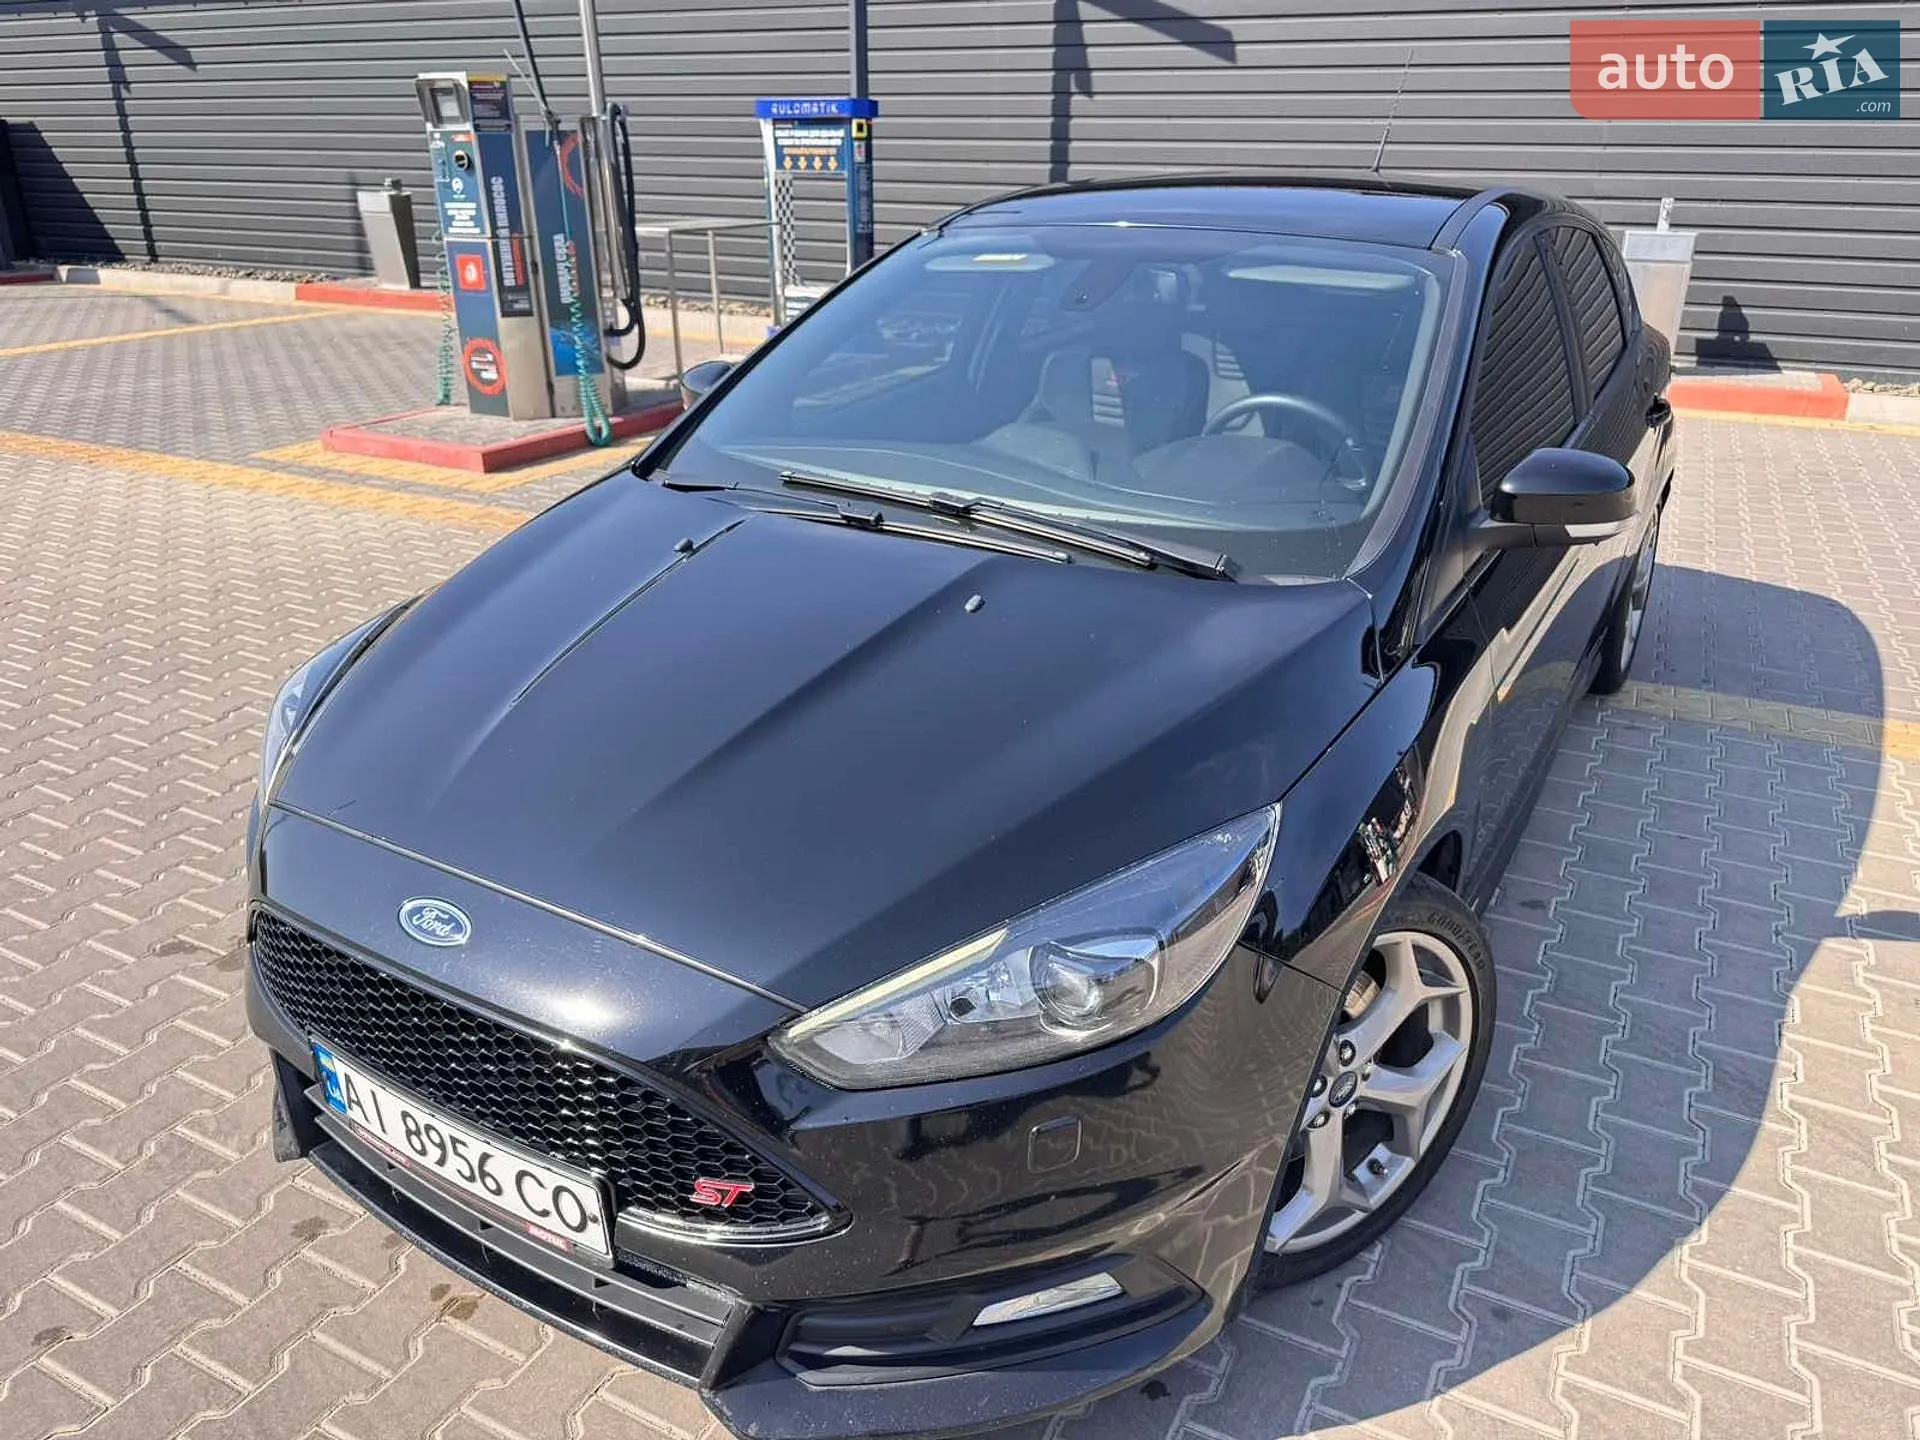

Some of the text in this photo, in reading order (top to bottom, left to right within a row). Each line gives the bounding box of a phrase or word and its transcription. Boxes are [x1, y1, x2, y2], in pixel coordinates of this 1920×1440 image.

[412, 907, 456, 937] Ford
[344, 1072, 388, 1135] AI
[401, 1109, 503, 1197] 8956
[515, 1169, 589, 1234] CO
[689, 1177, 755, 1209] ST
